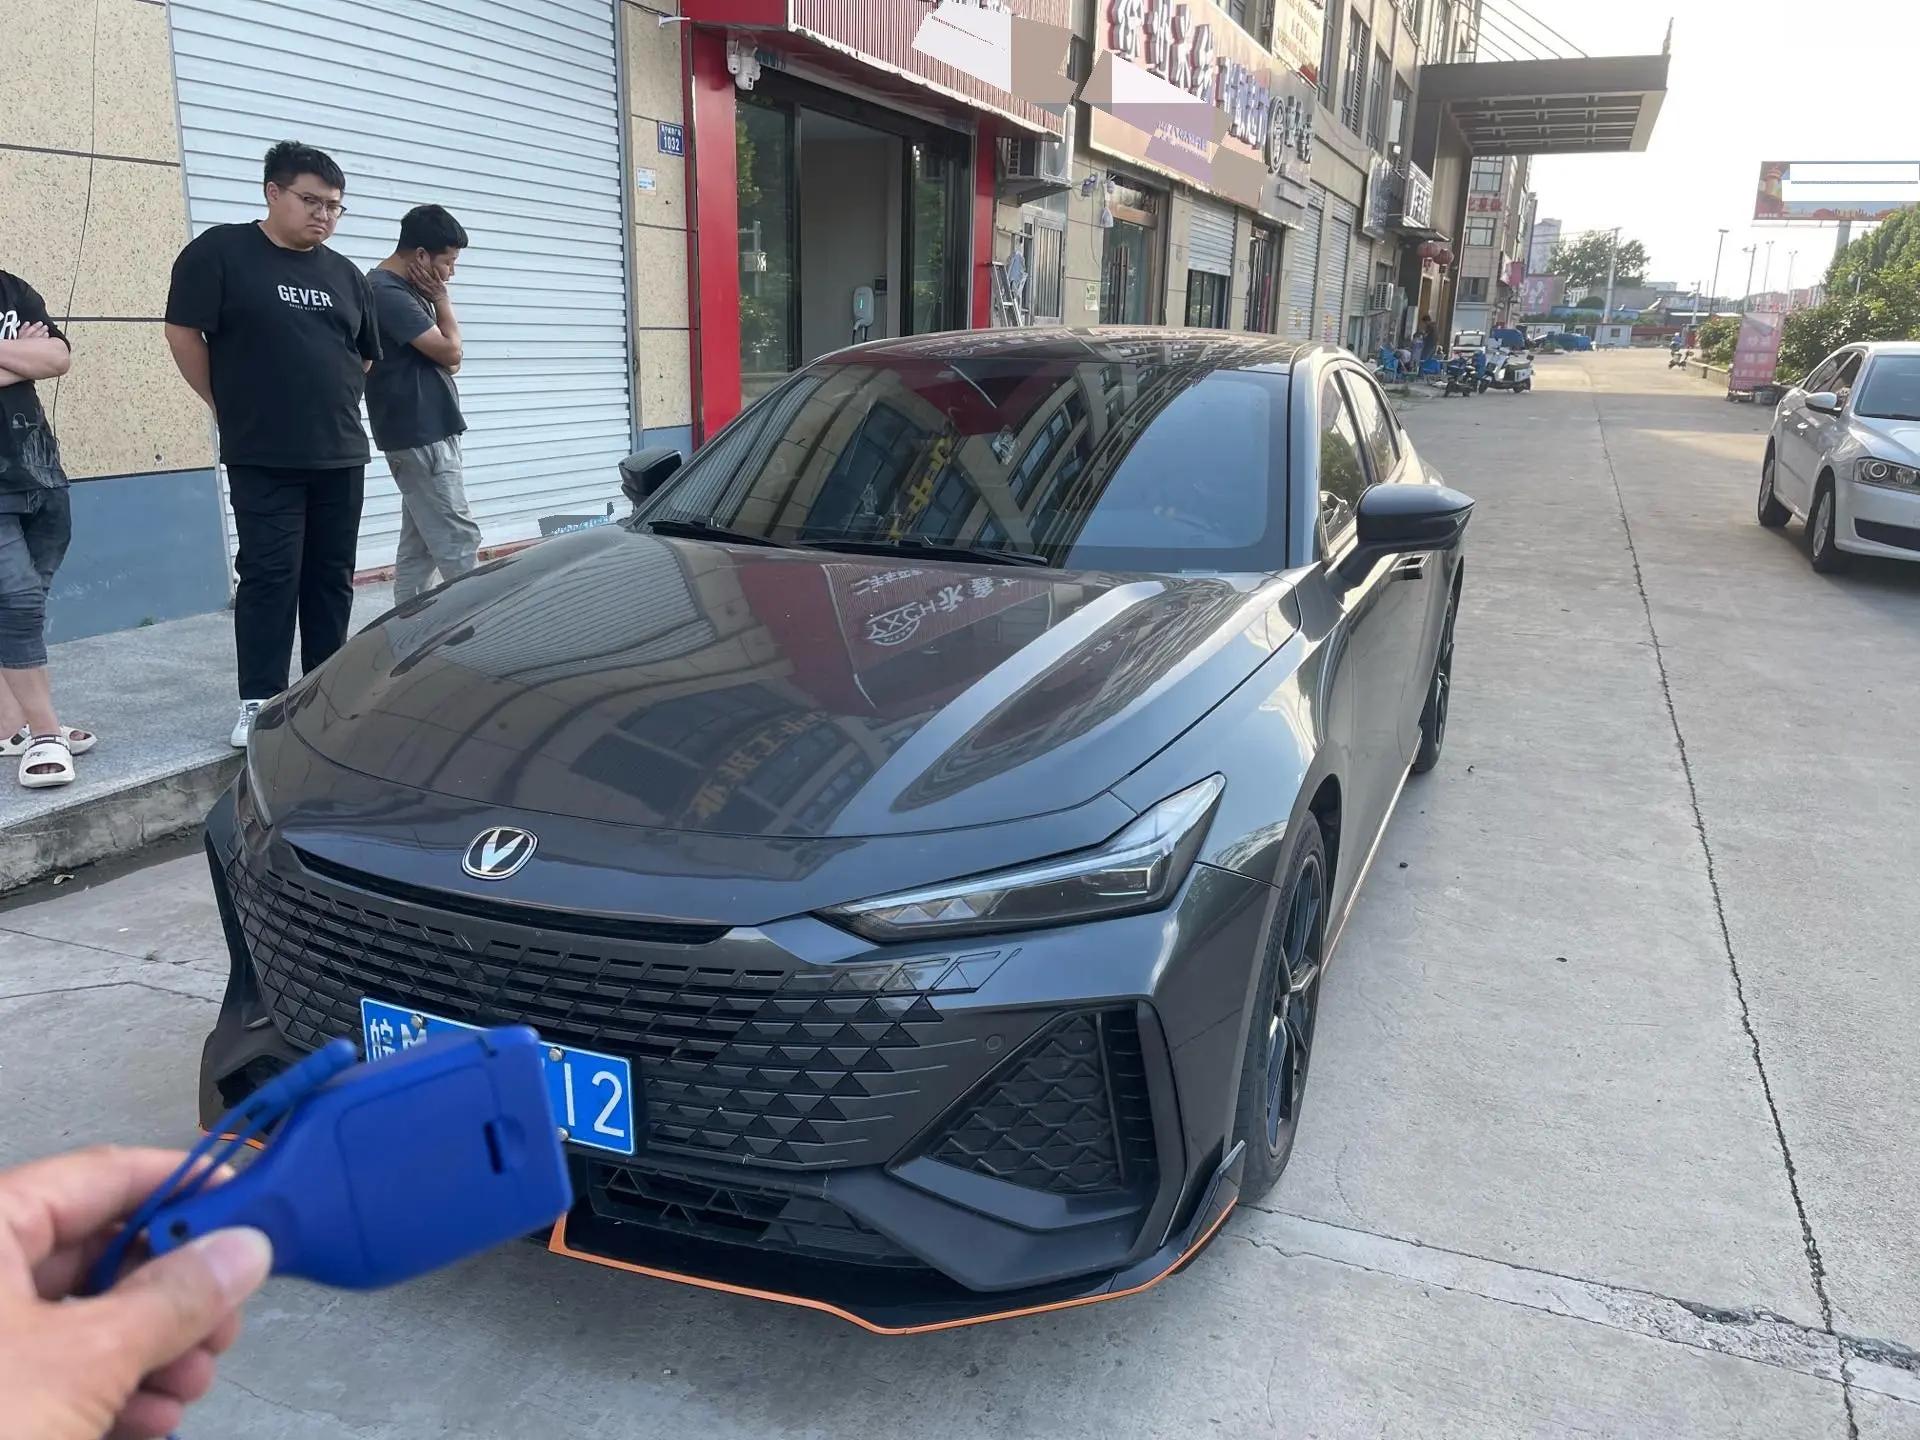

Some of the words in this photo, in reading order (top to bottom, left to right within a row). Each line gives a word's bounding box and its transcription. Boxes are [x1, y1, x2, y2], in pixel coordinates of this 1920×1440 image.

[664, 135, 680, 151] 1032
[277, 284, 333, 307] GEVER
[541, 1057, 625, 1138] 12
